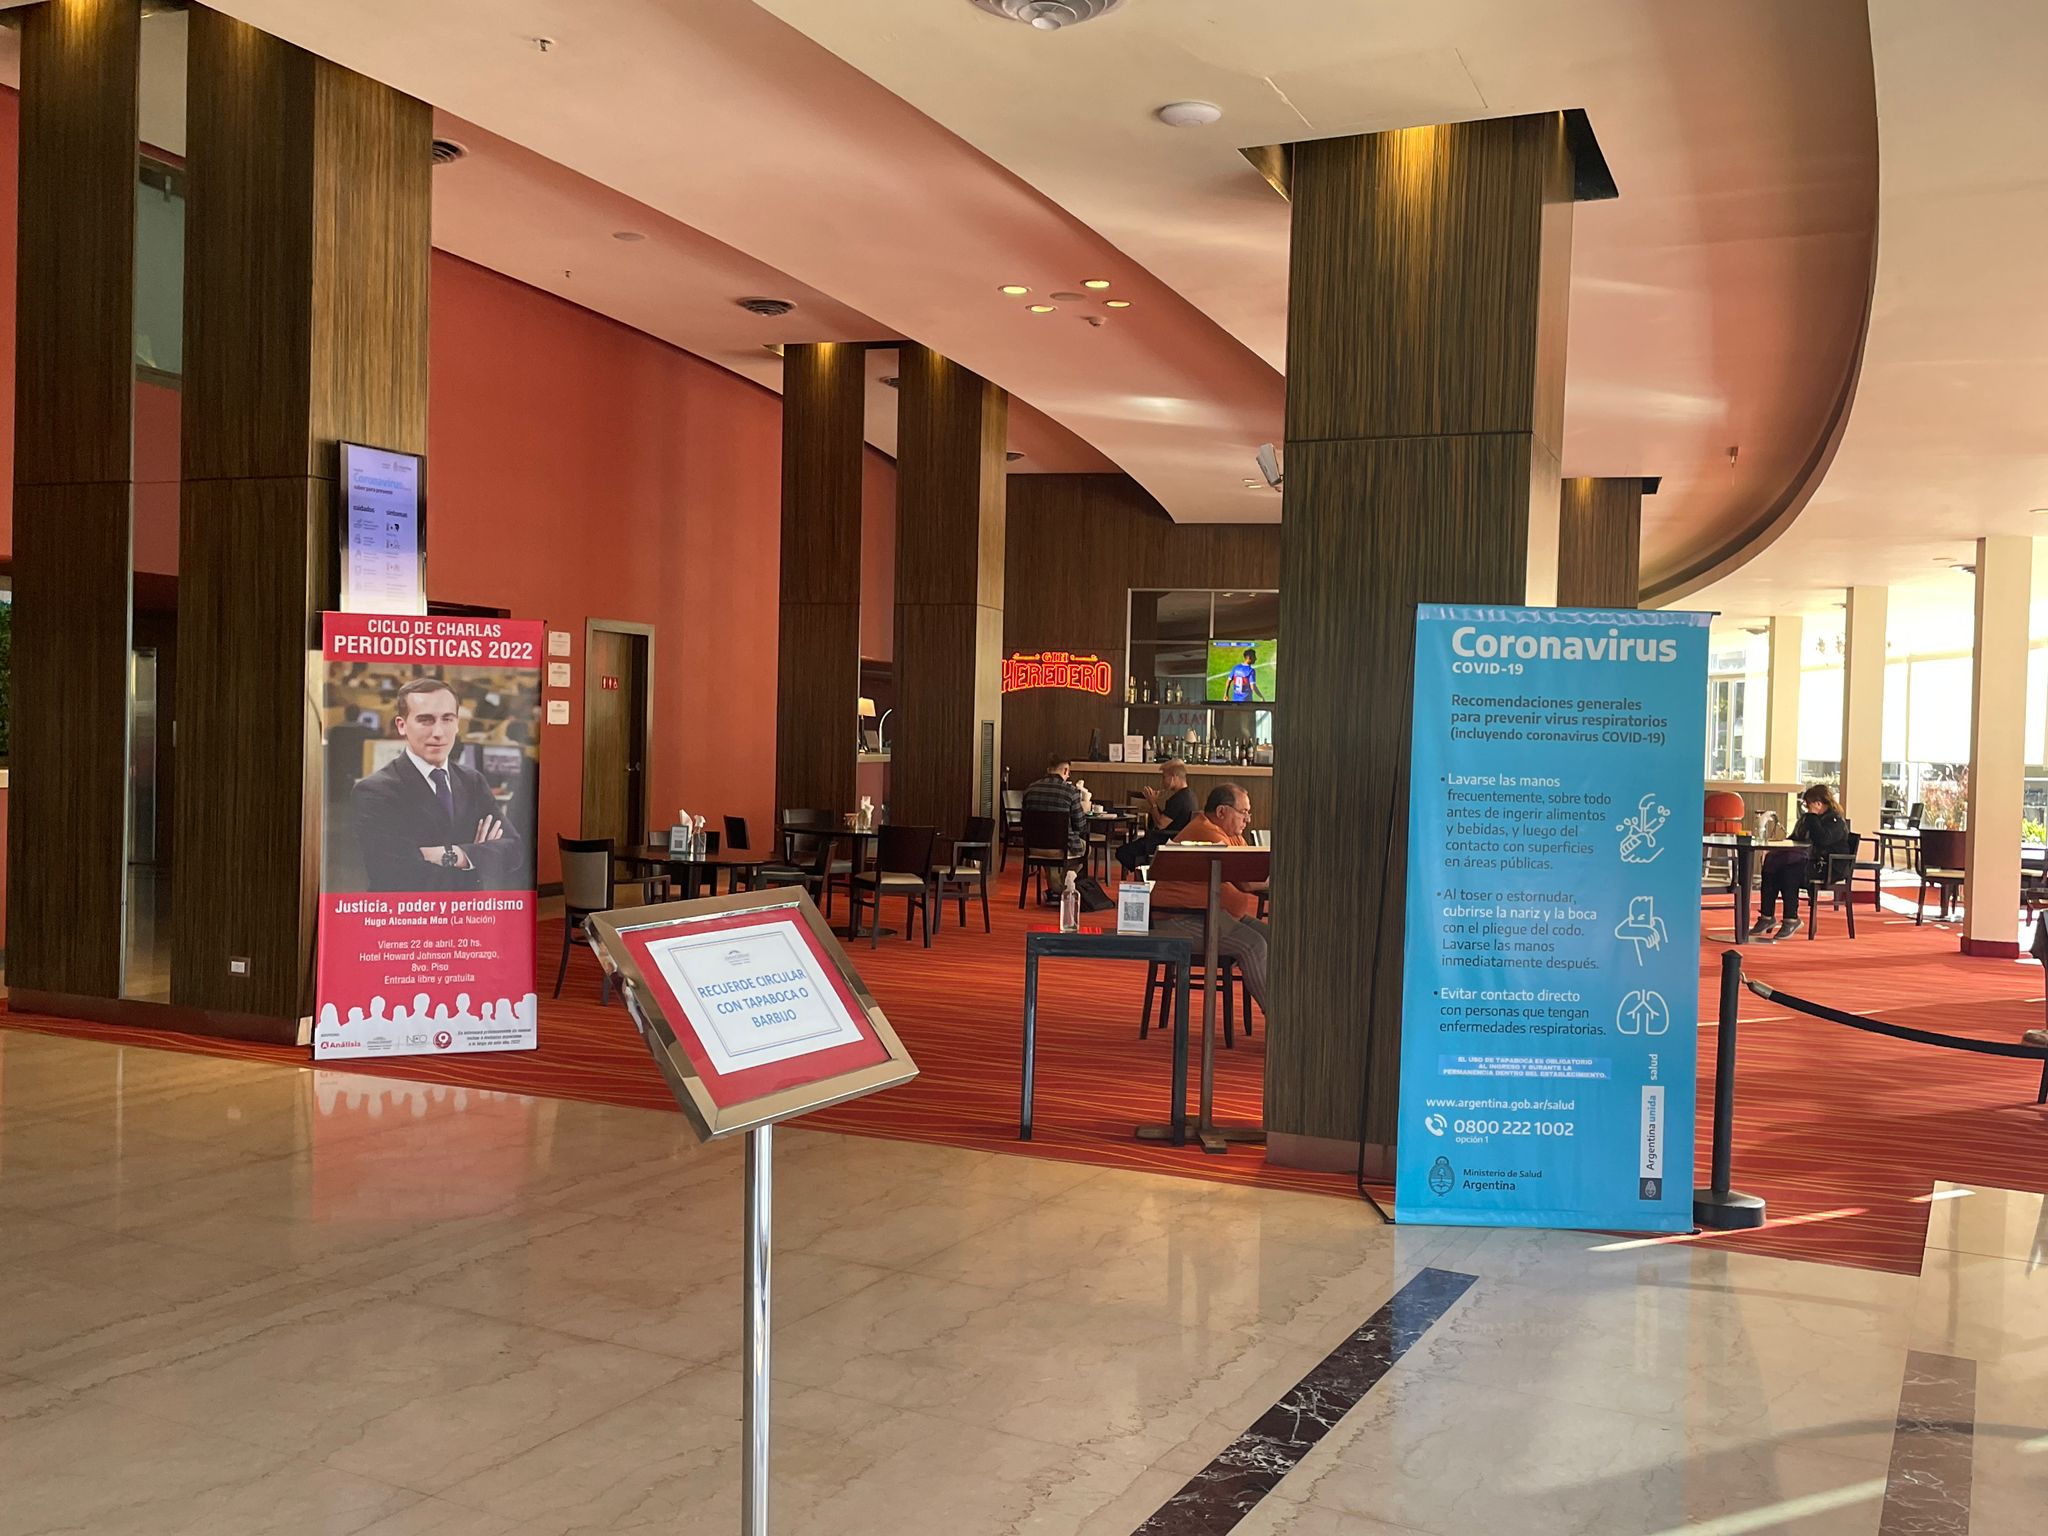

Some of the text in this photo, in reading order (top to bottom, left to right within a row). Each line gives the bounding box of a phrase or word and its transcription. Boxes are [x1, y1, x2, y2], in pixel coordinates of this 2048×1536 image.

[368, 619, 501, 637] CICLO DE CHARLAS
[334, 634, 482, 658] PERIODÍSTICAS
[489, 642, 533, 660] 2022
[1452, 627, 1677, 662] Coronavirus
[1042, 652, 1069, 663] GIN
[1452, 662, 1524, 675] COVID-19
[1001, 660, 1111, 695] HEREDERO
[1452, 694, 1642, 712] Recomendaciones generales
[1451, 712, 1667, 730] para prevenir virus respiratorios
[1450, 728, 1665, 746] (incluyendo coronavirus COVID-19)
[1448, 774, 1560, 787] Lavarse las manos
[1448, 789, 1611, 805] frecuentemente, sobre todo
[1446, 807, 1606, 821] antes de ingerir alimentos
[1446, 823, 1578, 839] y bebidas, y luego del
[1446, 841, 1594, 856] contacto con superficies
[1445, 855, 1553, 871] en áreas públicas.
[1443, 889, 1577, 905] Al toser o estornudar,
[335, 898, 524, 915] Justicia, poder y periodismo
[1443, 905, 1597, 922] cubrirse la nariz y la boca
[364, 915, 496, 928] Hugo Alconada Mon (La Nación)
[1443, 922, 1584, 938] con el pliegue del codo.
[378, 940, 409, 950] Viernes
[411, 940, 421, 949] 22
[423, 939, 433, 949] de
[457, 939, 468, 948] 20
[470, 939, 482, 948] hs.
[1443, 939, 1555, 952] Lavarse las manos
[360, 952, 381, 962] Hotel
[383, 951, 415, 961] Howard
[417, 951, 451, 961] Johnson
[1442, 955, 1600, 971] inmediatamente después.
[411, 963, 449, 972] 8vo. Piso
[384, 974, 475, 985] Entrada libre y gratuita
[698, 969, 806, 998] RECUERDE CIRCULAR
[717, 987, 809, 1015] CON TAPABOCA O
[1441, 987, 1580, 1002] Evitar contacto directo
[752, 1009, 797, 1028] BARBIJO
[1440, 1006, 1589, 1022] con personas que tengan
[1440, 1021, 1606, 1038] enfermedades respiratorias.
[1540, 1071, 1607, 1079] ESTABLECIMIENTO.
[1649, 1054, 1658, 1081] salud
[1426, 1098, 1575, 1111] www.argentina.gob.ar/salud
[1454, 1120, 1574, 1136] 0800 222 1002
[1646, 1095, 1658, 1170] Argentina unida
[1456, 1136, 1489, 1145] opción 1
[1463, 1168, 1543, 1179] Ministerio de Salud
[1463, 1180, 1516, 1192] Argentina
